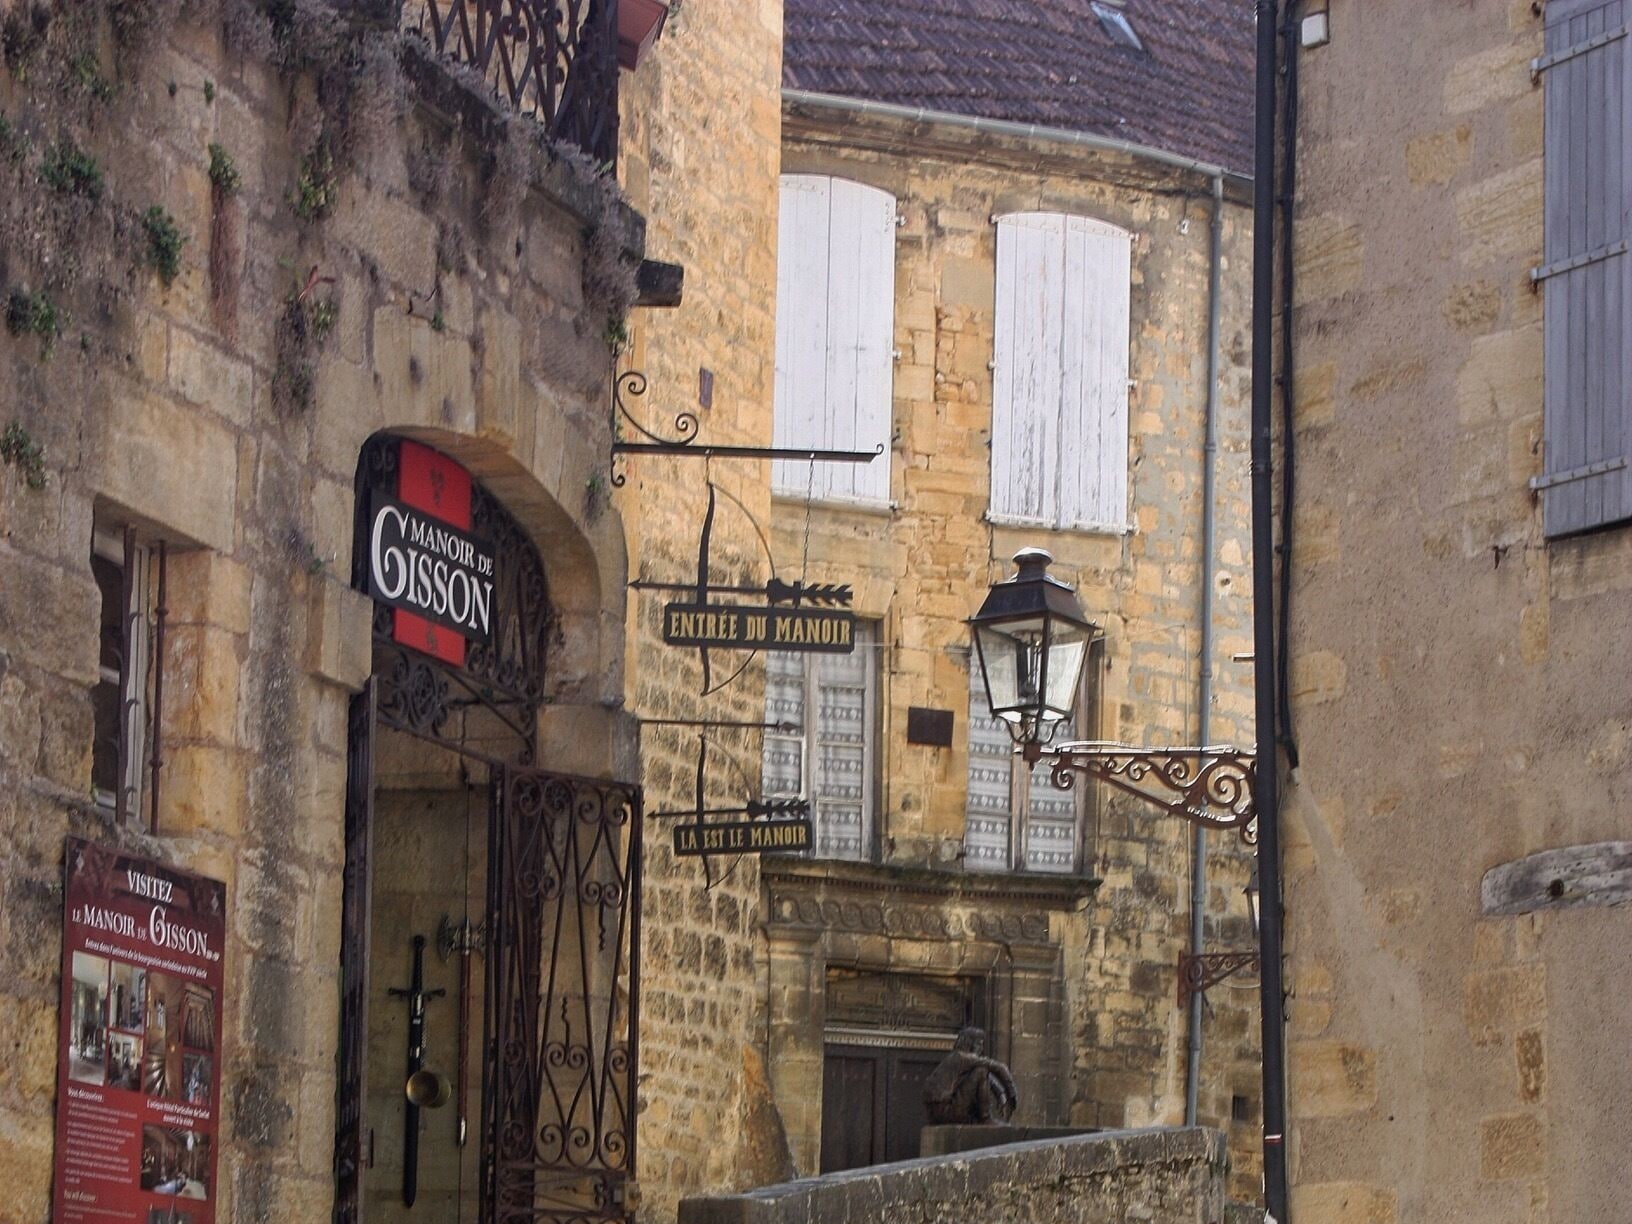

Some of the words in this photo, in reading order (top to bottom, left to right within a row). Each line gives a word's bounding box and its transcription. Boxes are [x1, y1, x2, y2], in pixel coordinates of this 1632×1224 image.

[371, 504, 493, 636] GISSON
[410, 518, 475, 565] MANOIR
[477, 553, 494, 577] DE
[669, 610, 738, 641] ENTRÉE
[744, 615, 768, 641] DU
[773, 616, 851, 645] MANOIR
[702, 828, 725, 850] EST
[728, 828, 744, 849] LE
[750, 825, 807, 847] MANOIR
[127, 869, 173, 903] VISITEZ
[72, 907, 82, 922] LE
[83, 903, 136, 938] MANOIR
[149, 905, 208, 959] GISSON
